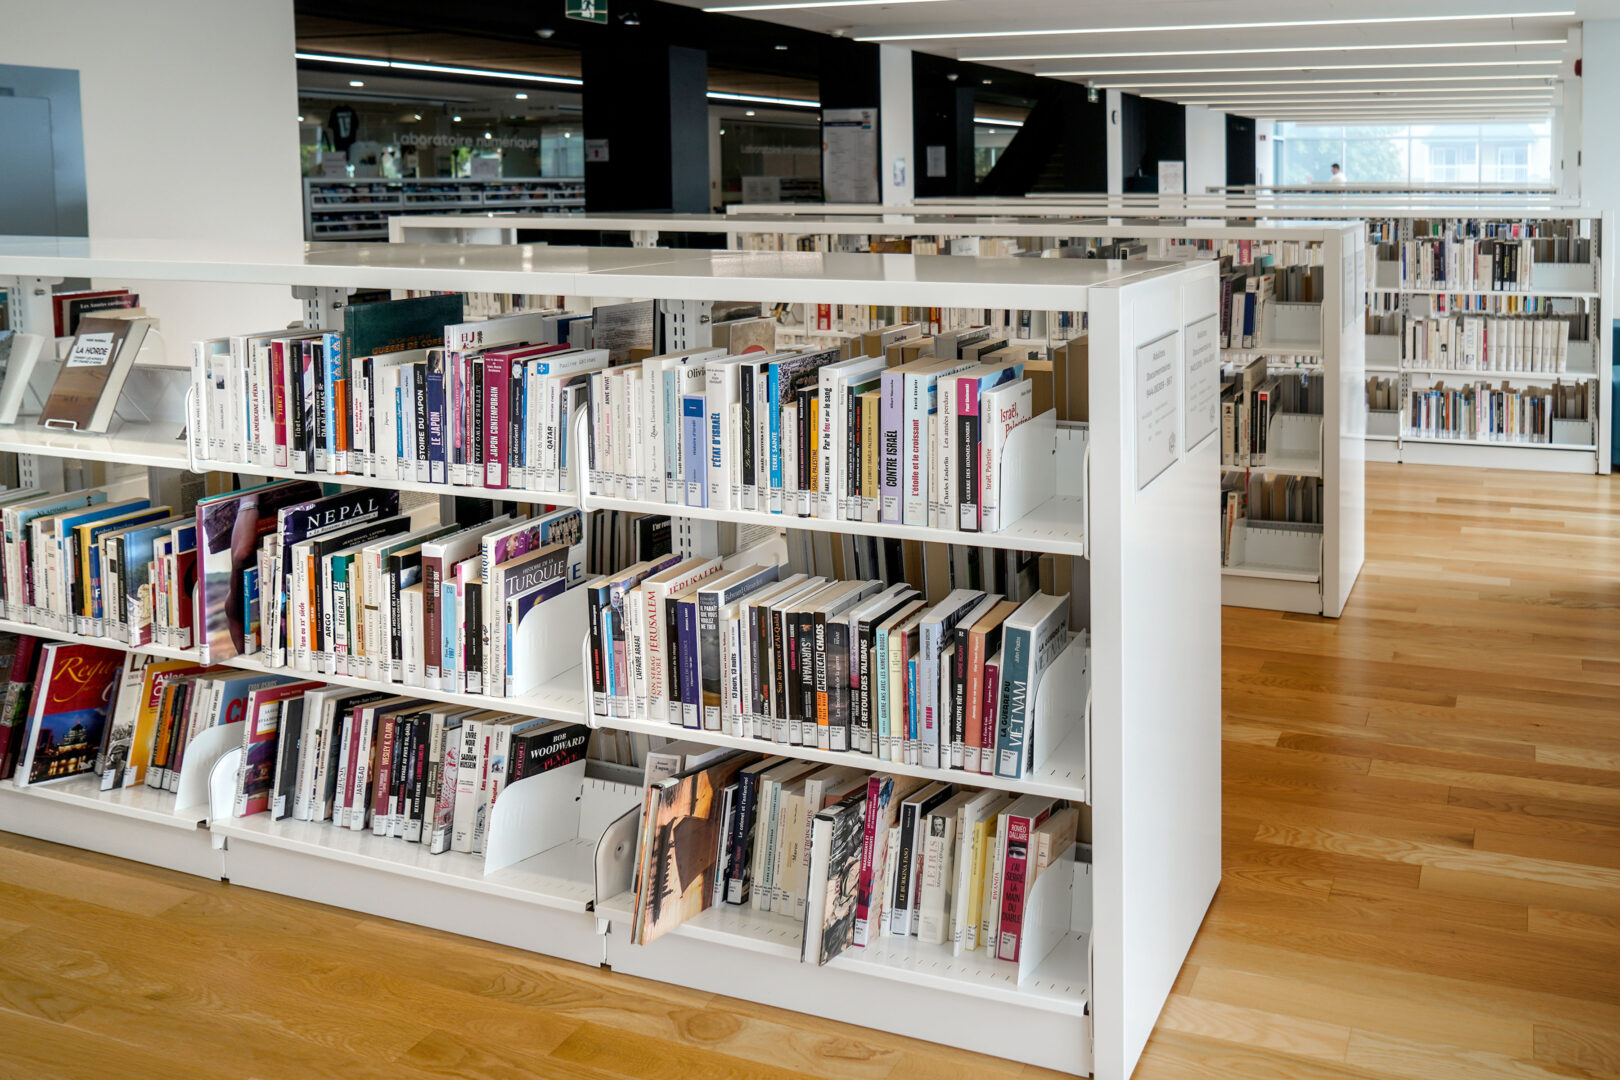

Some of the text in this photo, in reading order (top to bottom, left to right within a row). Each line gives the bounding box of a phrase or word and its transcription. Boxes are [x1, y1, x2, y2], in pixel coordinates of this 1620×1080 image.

[393, 132, 538, 151] Laboratoire numérique
[85, 347, 108, 355] HORDE
[372, 343, 405, 354] GUERRE
[823, 388, 832, 402] sang
[490, 387, 498, 434] CONTEMPORAIN
[1000, 402, 1018, 424] Israël,
[418, 417, 424, 429] DU
[430, 412, 440, 436] JAPON
[711, 412, 721, 467] L'ÉTAT D'ISRAËL
[884, 430, 897, 486] CONTRE ISRAËL
[307, 498, 379, 530] NEPAL
[506, 560, 564, 595] TURQUIE
[426, 565, 435, 613] GAZA 1956
[647, 591, 659, 652] JÉRUSALEM
[802, 642, 812, 685] SURVIVANT
[816, 624, 825, 690] AMERICAN CHAOS
[1000, 681, 1010, 737] LA GUERRE DU
[1007, 681, 1026, 746] VIÊT NAM
[384, 723, 393, 738] CLARK
[553, 733, 567, 743] BOB
[382, 746, 390, 765] WESLEY
[530, 736, 585, 759] WOODWARD
[356, 766, 365, 796] JARHEAD
[1009, 831, 1028, 840] DALLAIRE
[1011, 824, 1026, 834] ROMÉO
[926, 840, 937, 887] LEIRIS
[1011, 863, 1020, 871] J'AI
[1006, 872, 1024, 882] SERRÉ
[1010, 883, 1018, 891] LA
[1006, 893, 1020, 902] MAIN
[1008, 904, 1016, 912] DU
